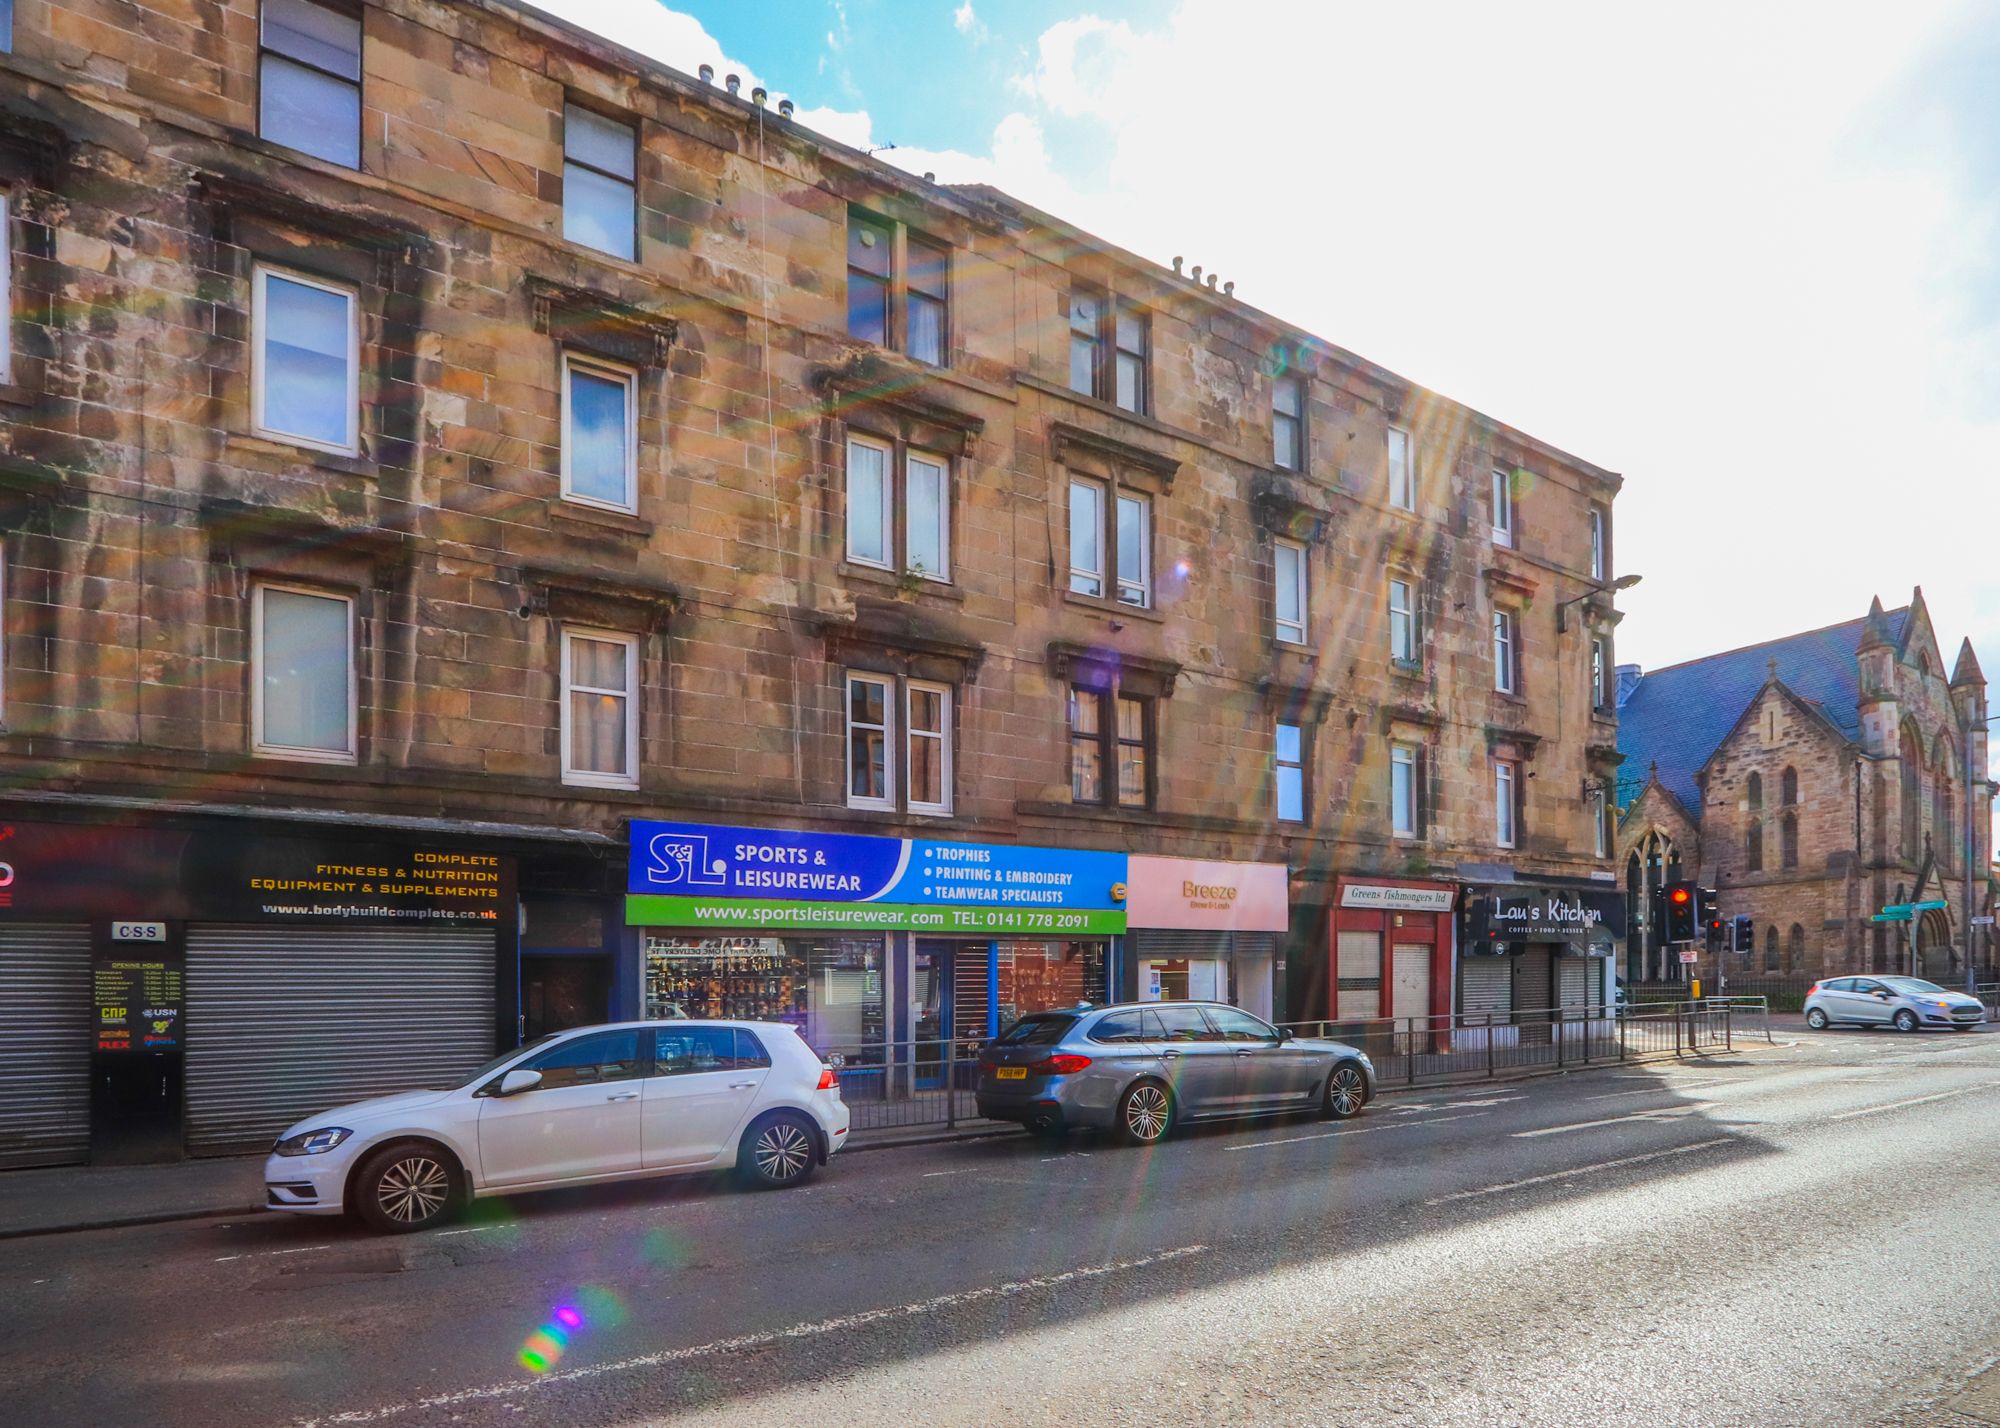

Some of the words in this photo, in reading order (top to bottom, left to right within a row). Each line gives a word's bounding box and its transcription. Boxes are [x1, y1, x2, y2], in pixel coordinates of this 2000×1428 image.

[414, 852, 498, 866] COMPLETE
[734, 844, 808, 865] SPORTS
[813, 850, 827, 866] &
[935, 847, 991, 863] TROPHIES
[316, 864, 389, 878] FITNESS
[395, 868, 406, 878] &
[412, 869, 498, 882] NUTRITION
[734, 870, 862, 892] LEISUREWEAR
[935, 866, 992, 882] PRINTING
[994, 870, 1003, 882] &
[1005, 870, 1073, 886] EMBROIDERY
[250, 878, 357, 892] EQUIPMENT
[361, 883, 373, 893] &
[379, 884, 498, 898] SUPPLEMENTS
[935, 886, 999, 902] TEAMWEAR
[1001, 888, 1064, 903] SPECIALISTS
[1182, 880, 1237, 900] Breeze
[1351, 888, 1381, 899] Greens
[1383, 889, 1433, 904] fishmongers
[1435, 892, 1447, 903] ltd
[262, 904, 498, 921] www.bodybuildcomplete.co.uk
[1494, 896, 1540, 920] Lau's
[952, 911, 983, 926] TEL:
[986, 912, 1022, 927] 0141
[1027, 913, 1053, 928] 778
[1056, 914, 1089, 928] 2091
